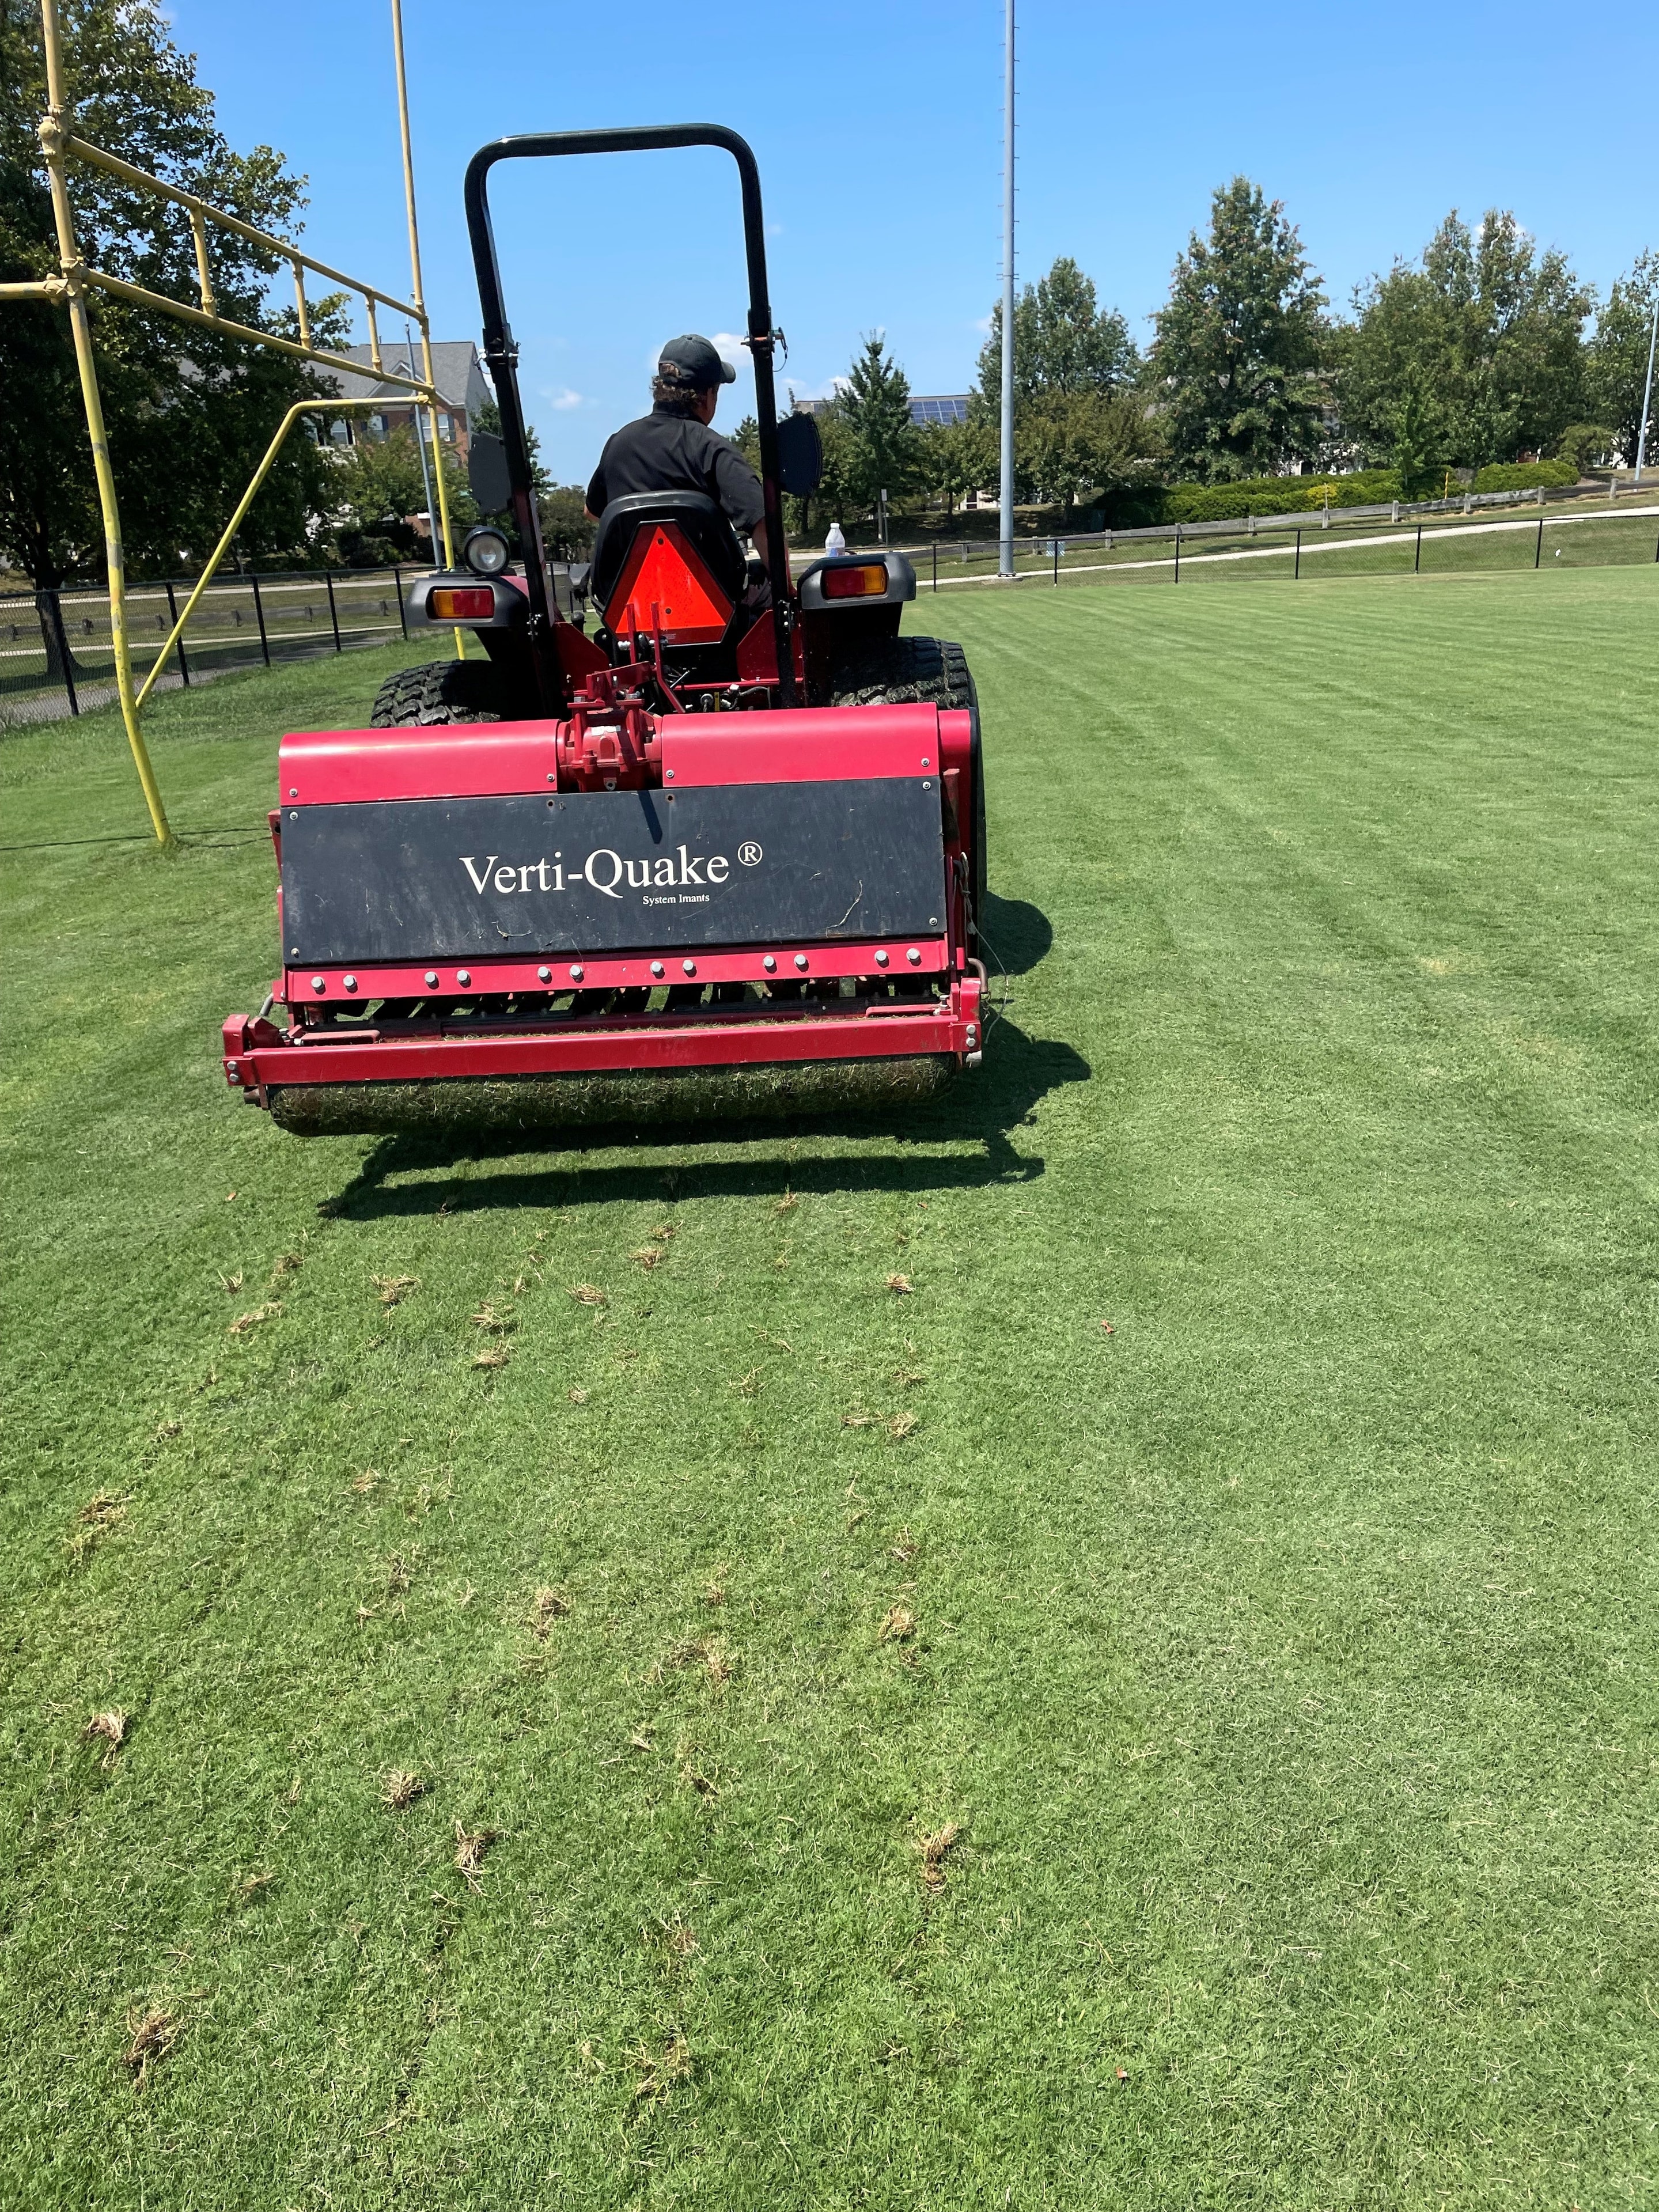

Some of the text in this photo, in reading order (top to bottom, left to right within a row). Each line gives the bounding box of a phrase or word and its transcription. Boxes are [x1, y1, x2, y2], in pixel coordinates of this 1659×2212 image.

[459, 844, 730, 899] Verti-Quake
[642, 893, 710, 907] System Imants
